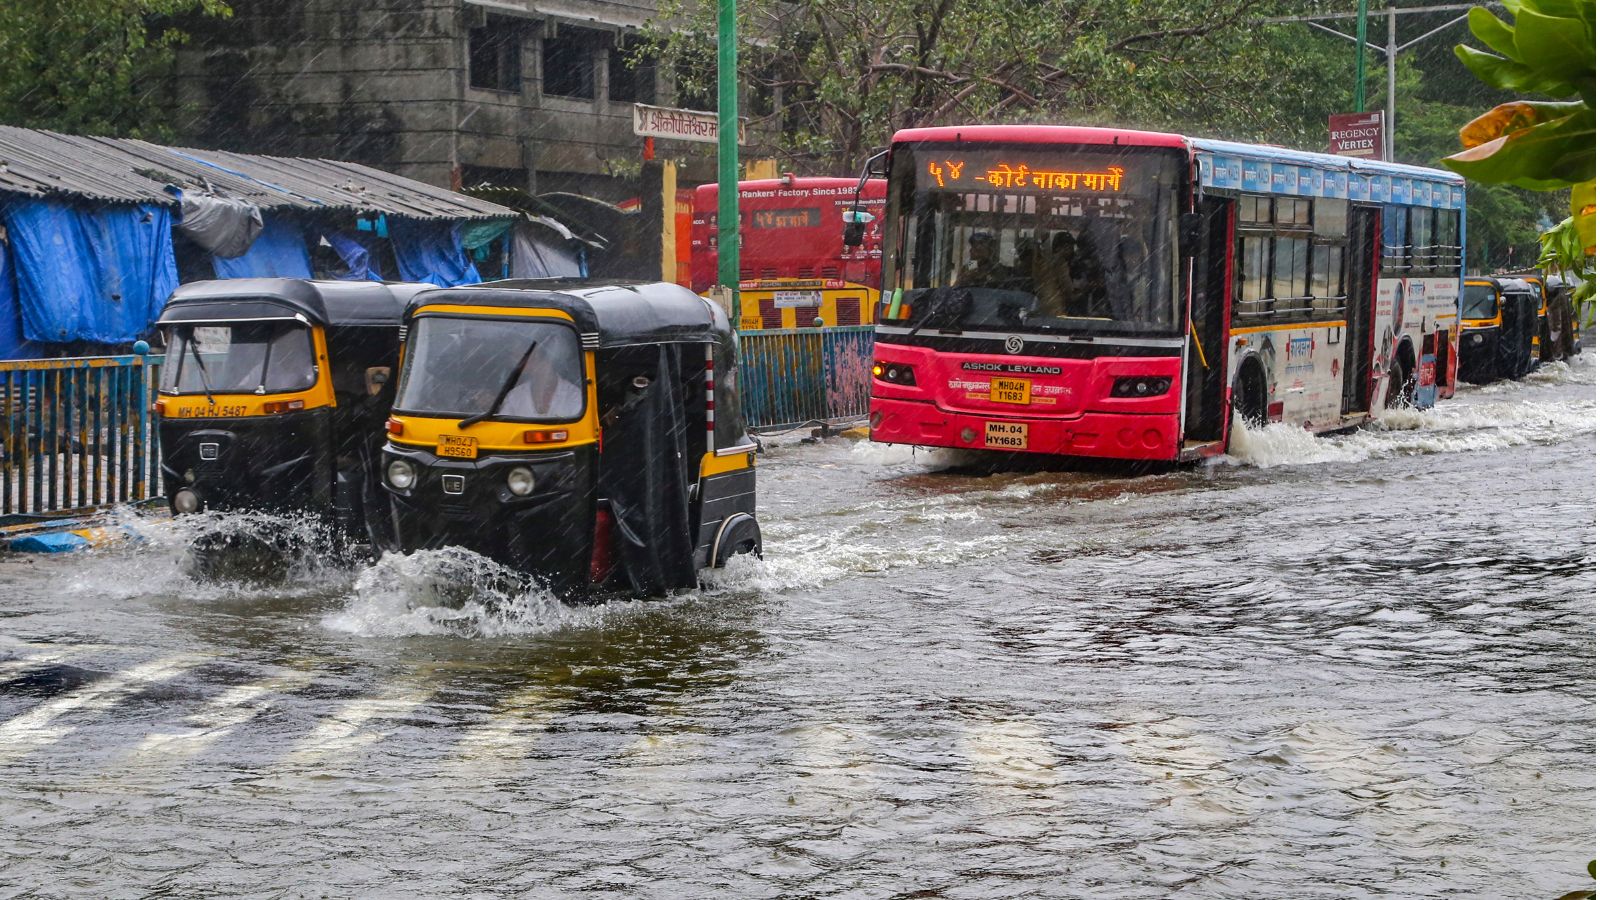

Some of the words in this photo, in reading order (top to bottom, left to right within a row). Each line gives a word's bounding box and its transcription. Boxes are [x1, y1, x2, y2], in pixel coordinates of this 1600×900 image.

[1331, 127, 1379, 140] REGENCY
[1337, 139, 1374, 150] VERTEX
[742, 190, 776, 198] Rankers'
[778, 188, 811, 197] Factory.
[812, 187, 835, 196] Since
[963, 362, 1001, 371] ASHOK
[1008, 365, 1060, 374] LEYLAND
[998, 381, 1025, 392] MH04H
[998, 391, 1023, 401] Y1683
[223, 405, 247, 416] 5487
